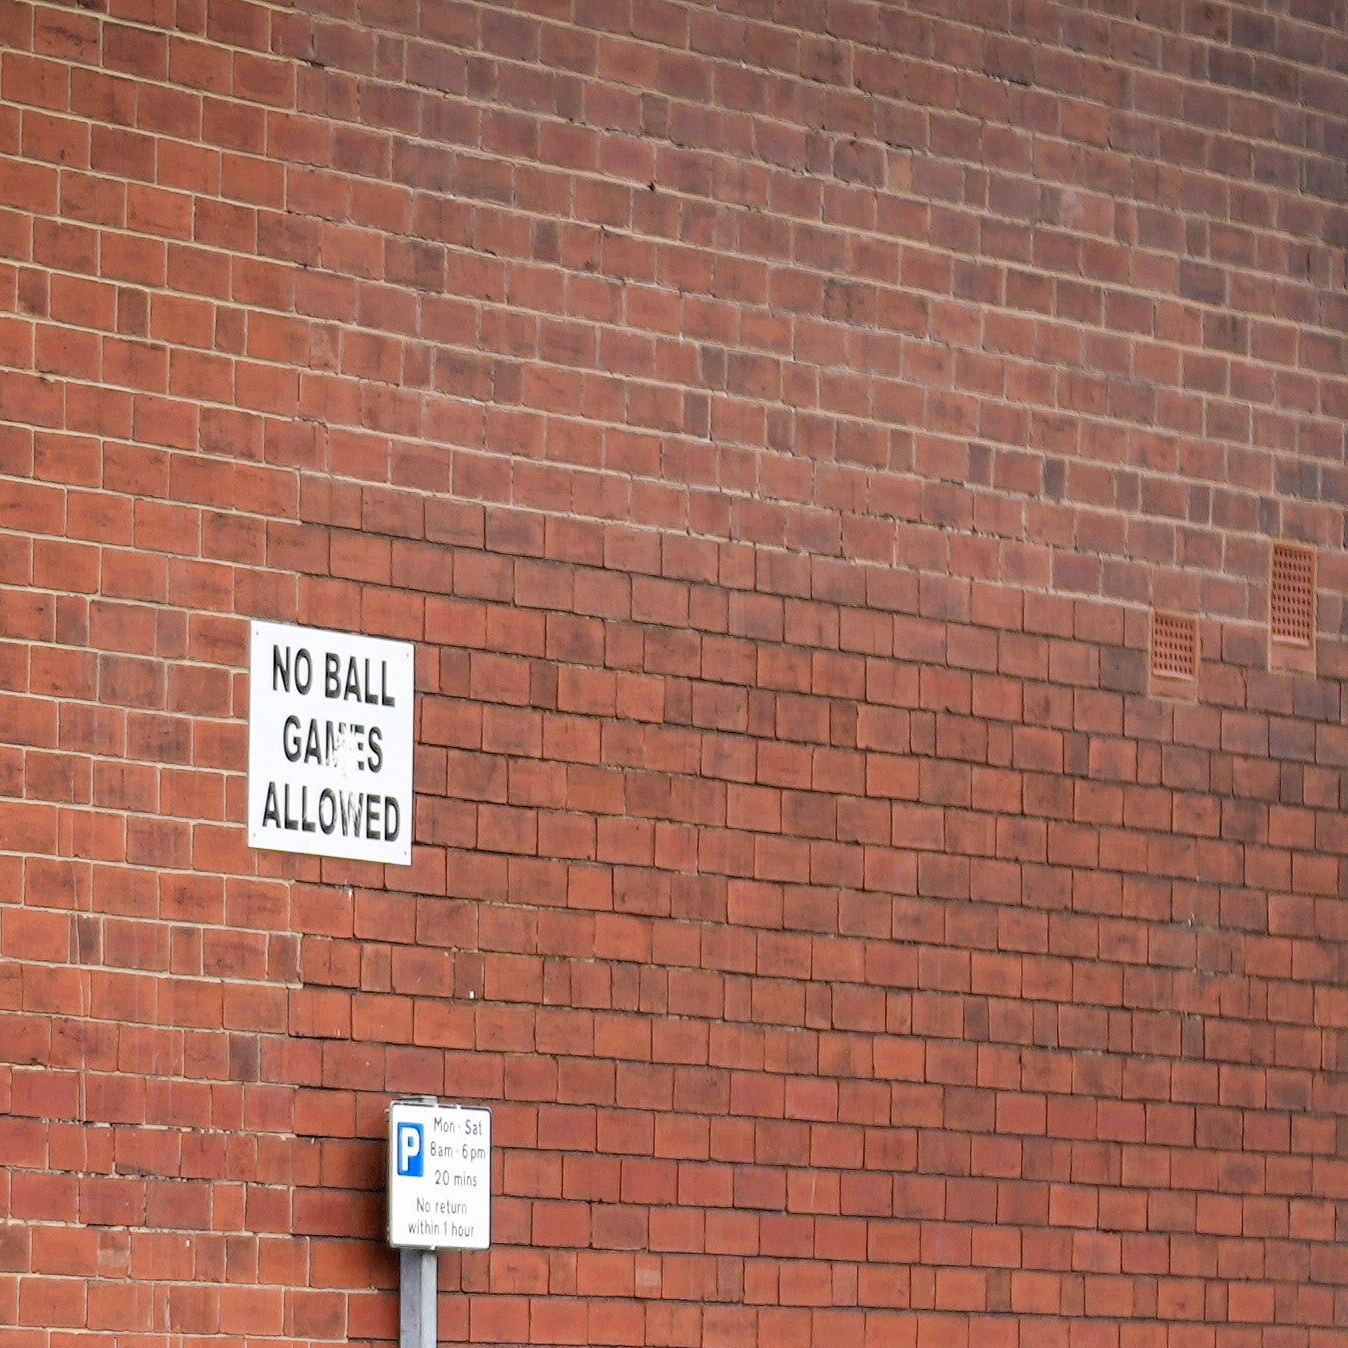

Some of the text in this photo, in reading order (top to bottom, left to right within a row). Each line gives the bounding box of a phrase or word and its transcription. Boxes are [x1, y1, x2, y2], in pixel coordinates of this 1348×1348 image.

[272, 644, 396, 708] NO BALL
[261, 780, 401, 842] ALLOWED
[433, 1116, 456, 1134] Mon
[465, 1118, 483, 1136] Sat
[401, 1126, 421, 1172] P
[434, 1169, 478, 1188] 20 mins
[416, 1196, 468, 1215] No return
[407, 1219, 475, 1238] within 1 hour
